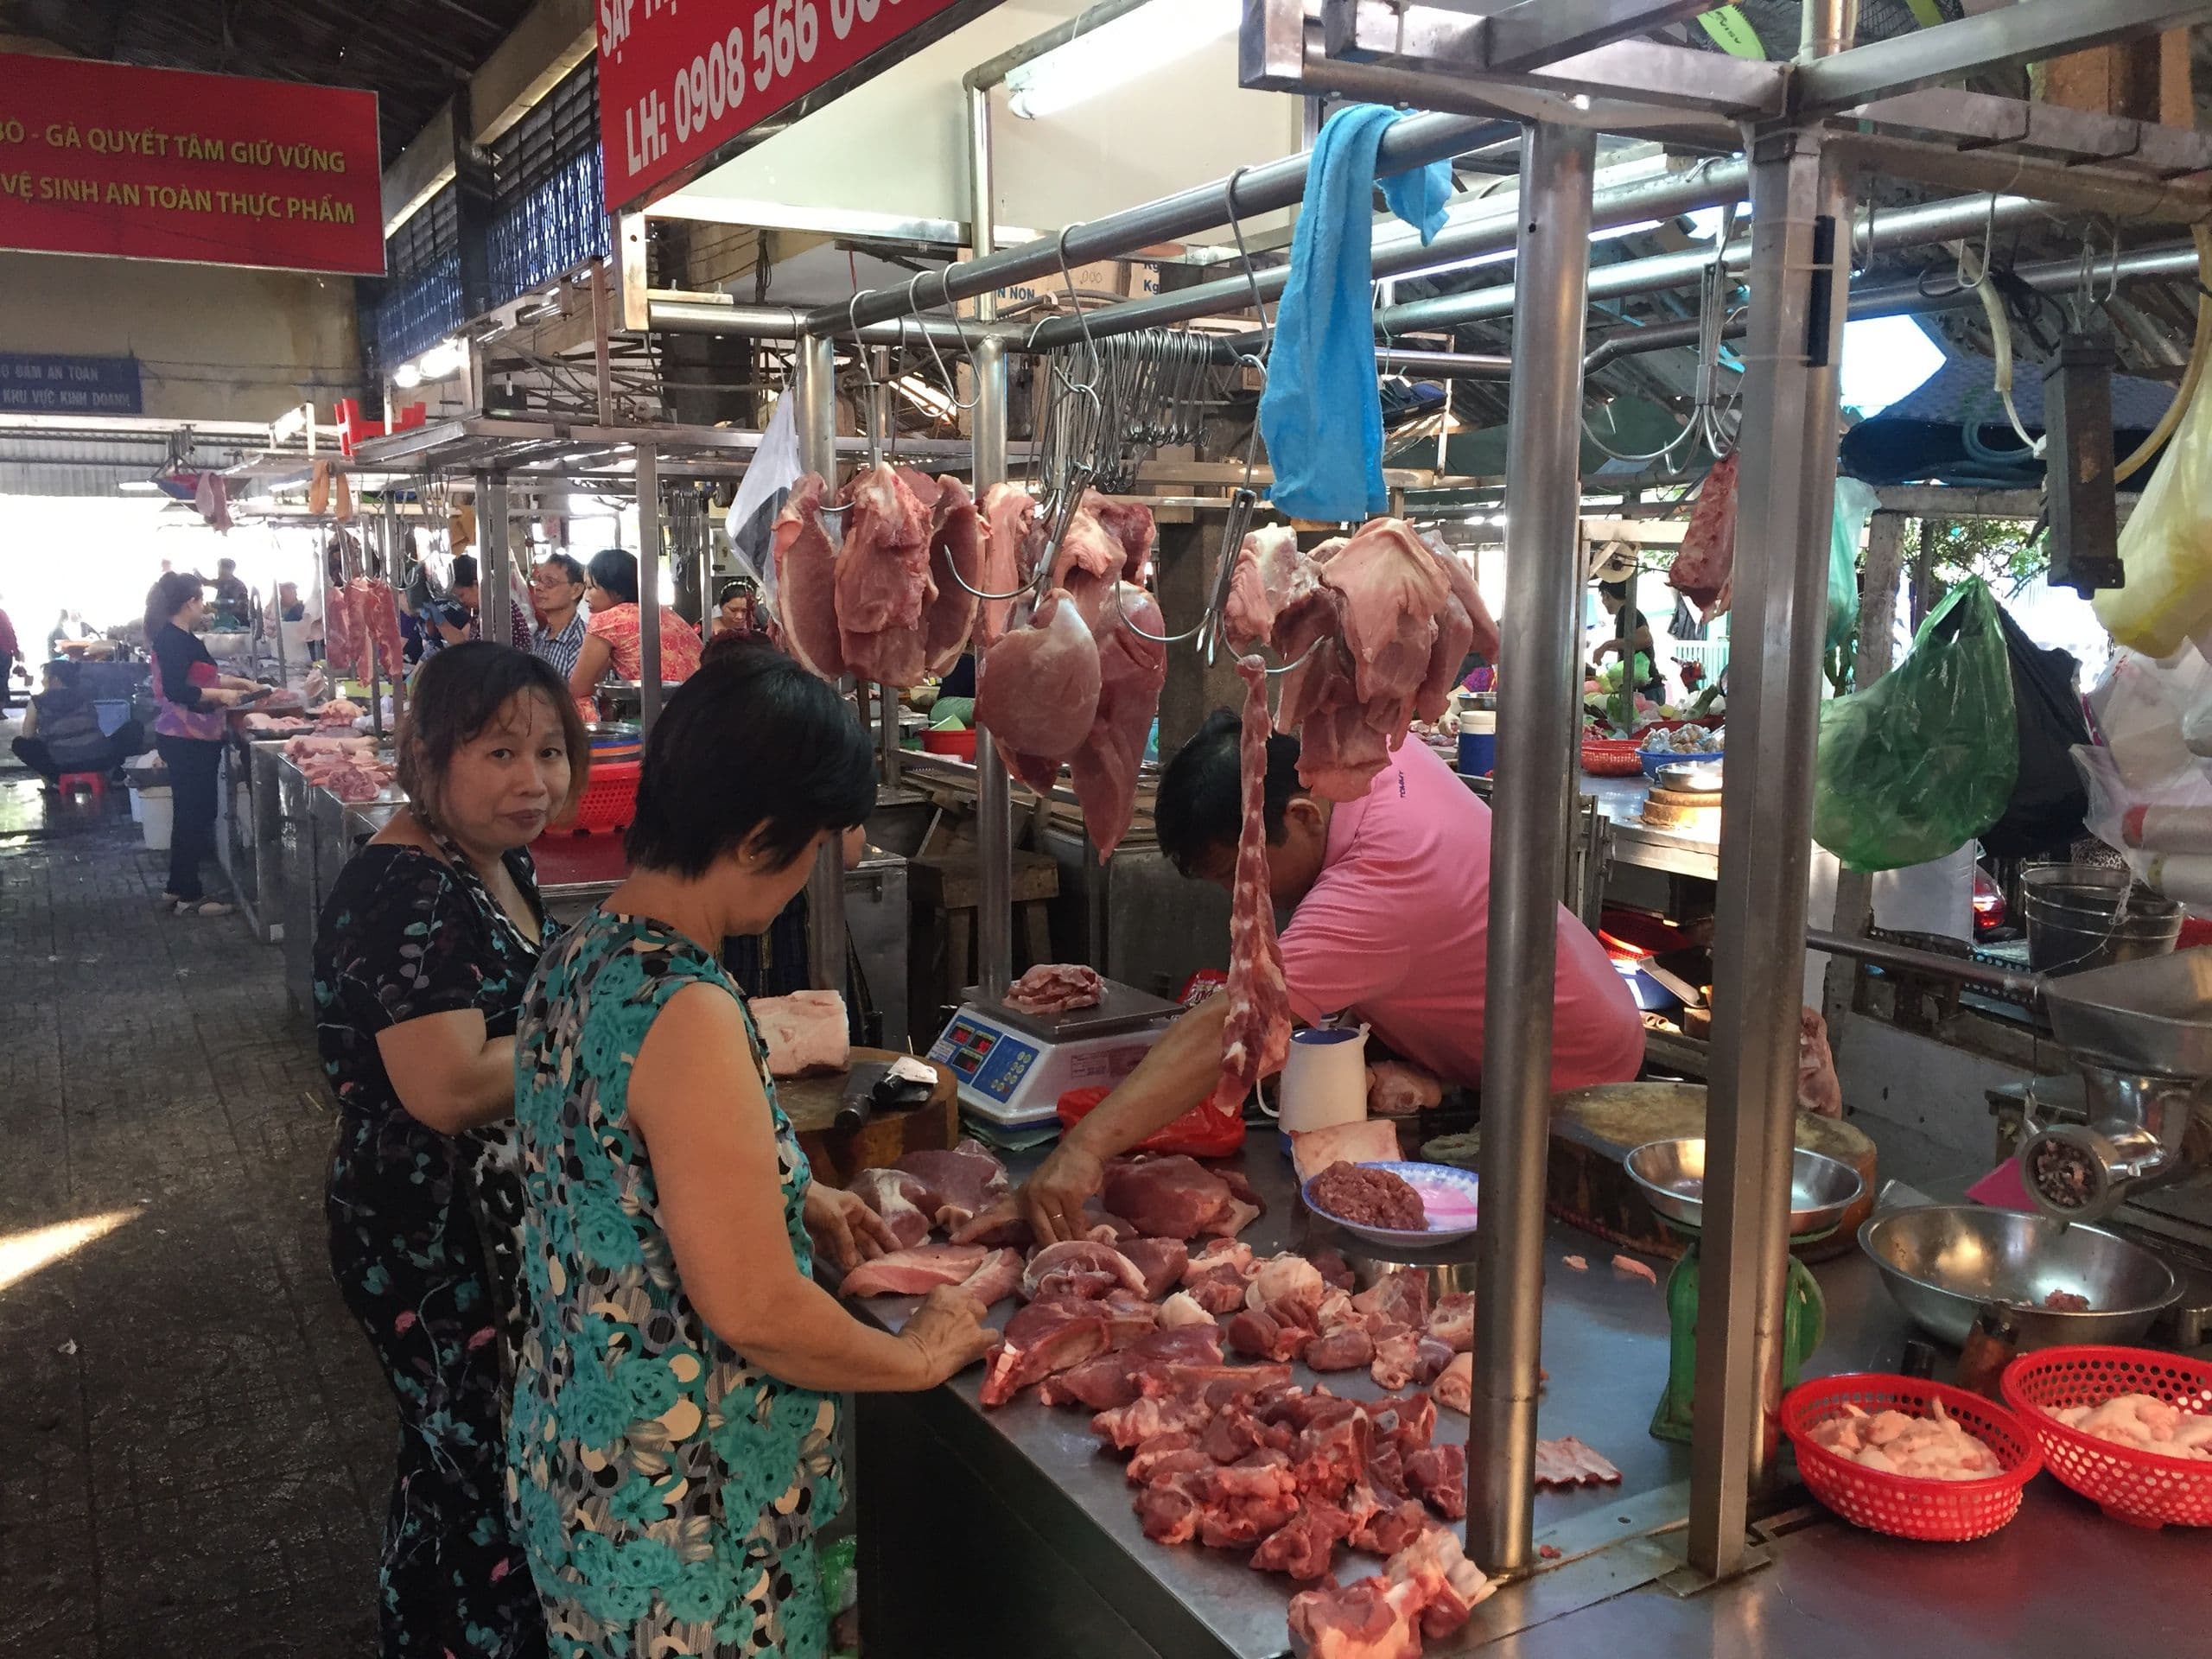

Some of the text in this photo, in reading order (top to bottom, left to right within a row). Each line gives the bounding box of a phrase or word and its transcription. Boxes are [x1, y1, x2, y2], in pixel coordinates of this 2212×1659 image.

[626, 89, 667, 176] LH:
[674, 27, 746, 143] 0908
[753, 0, 818, 92] 566
[45, 121, 82, 149] GÀ
[87, 126, 169, 156] QUYẾT
[174, 132, 225, 162] TÂM
[40, 176, 99, 203] SINH
[106, 182, 141, 207] AN
[144, 183, 213, 213] TOÀN
[216, 190, 282, 222] THỰC
[1009, 286, 1035, 301] NON
[1143, 279, 1160, 296] Kg
